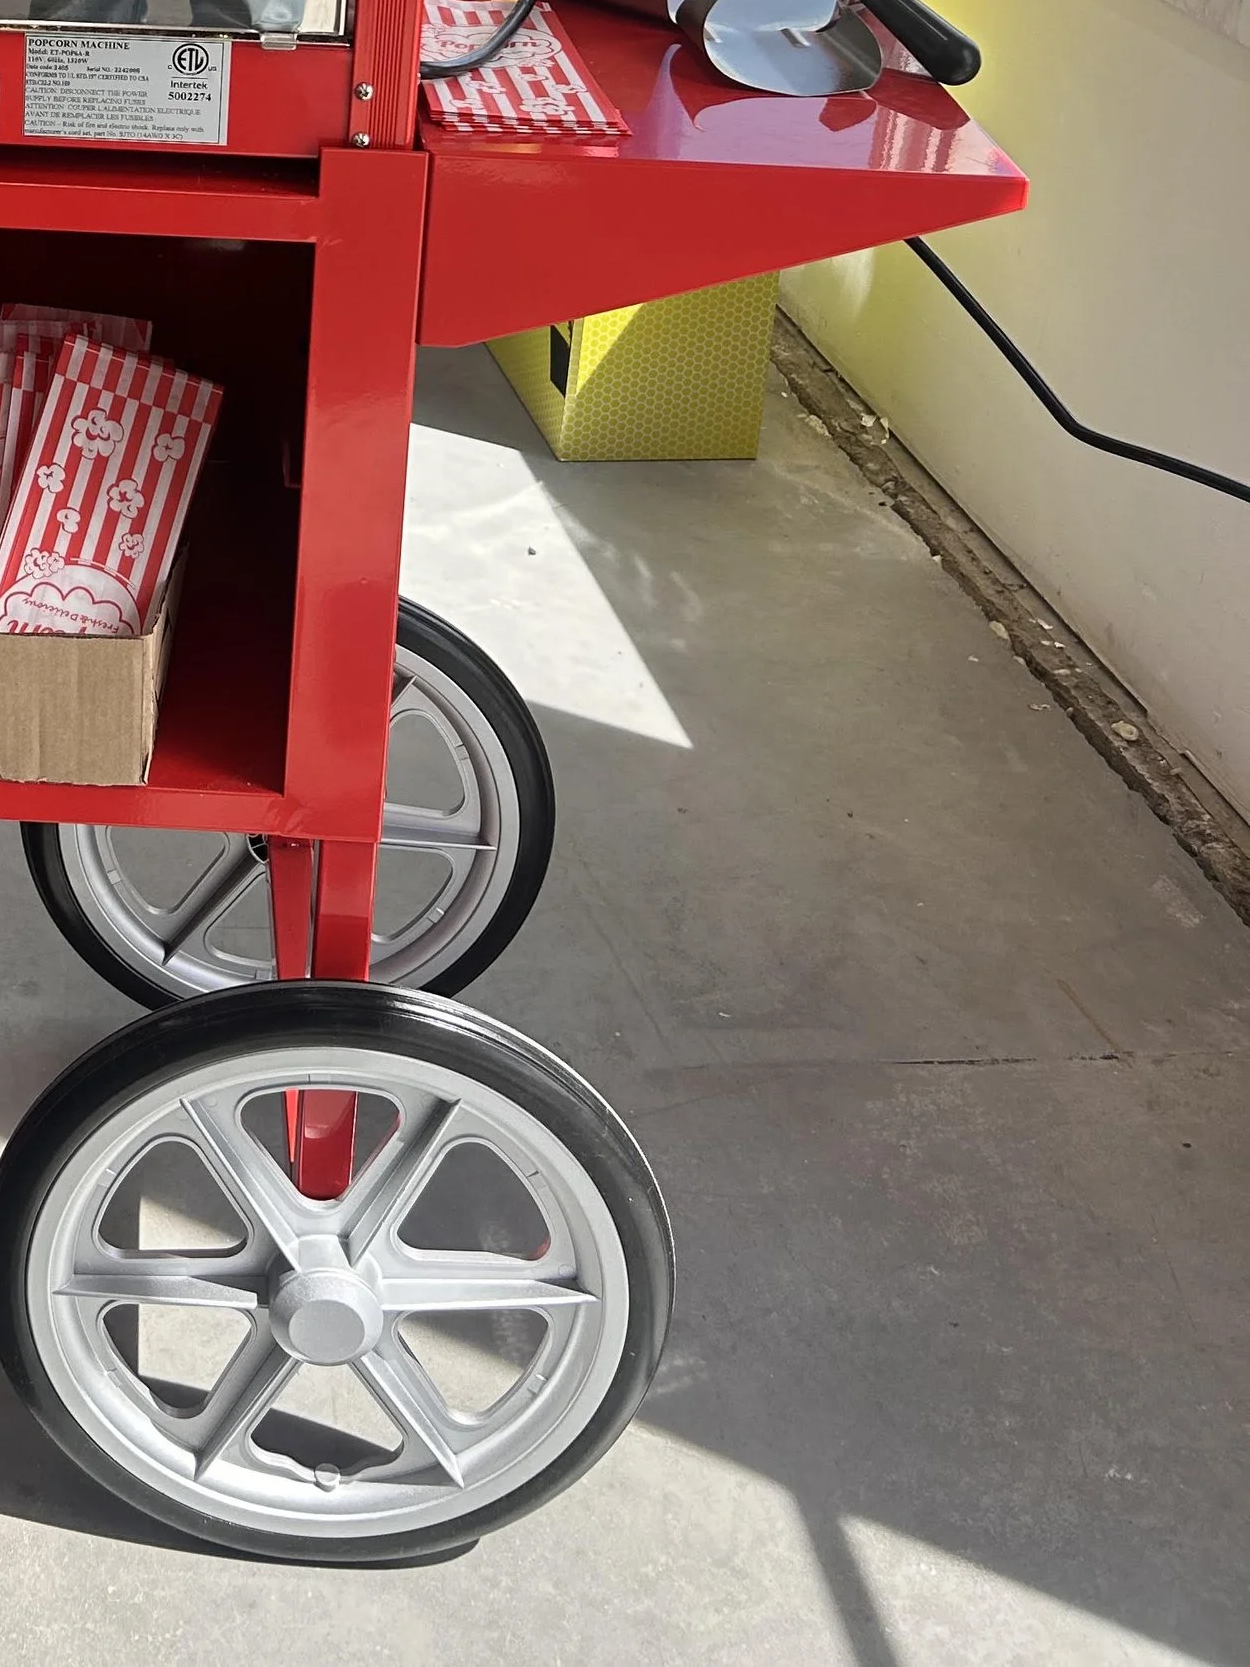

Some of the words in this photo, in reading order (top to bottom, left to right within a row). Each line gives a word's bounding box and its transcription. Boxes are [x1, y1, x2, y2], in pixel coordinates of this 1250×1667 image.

[28, 38, 78, 48] POPCORN
[81, 40, 130, 50] MACHINE
[177, 48, 204, 71] ETL
[170, 80, 208, 90] Intertek
[60, 88, 105, 96] DISCONNECT
[168, 91, 211, 101] 5002274
[53, 95, 81, 103] BEFORE
[22, 597, 78, 621] Delicious
